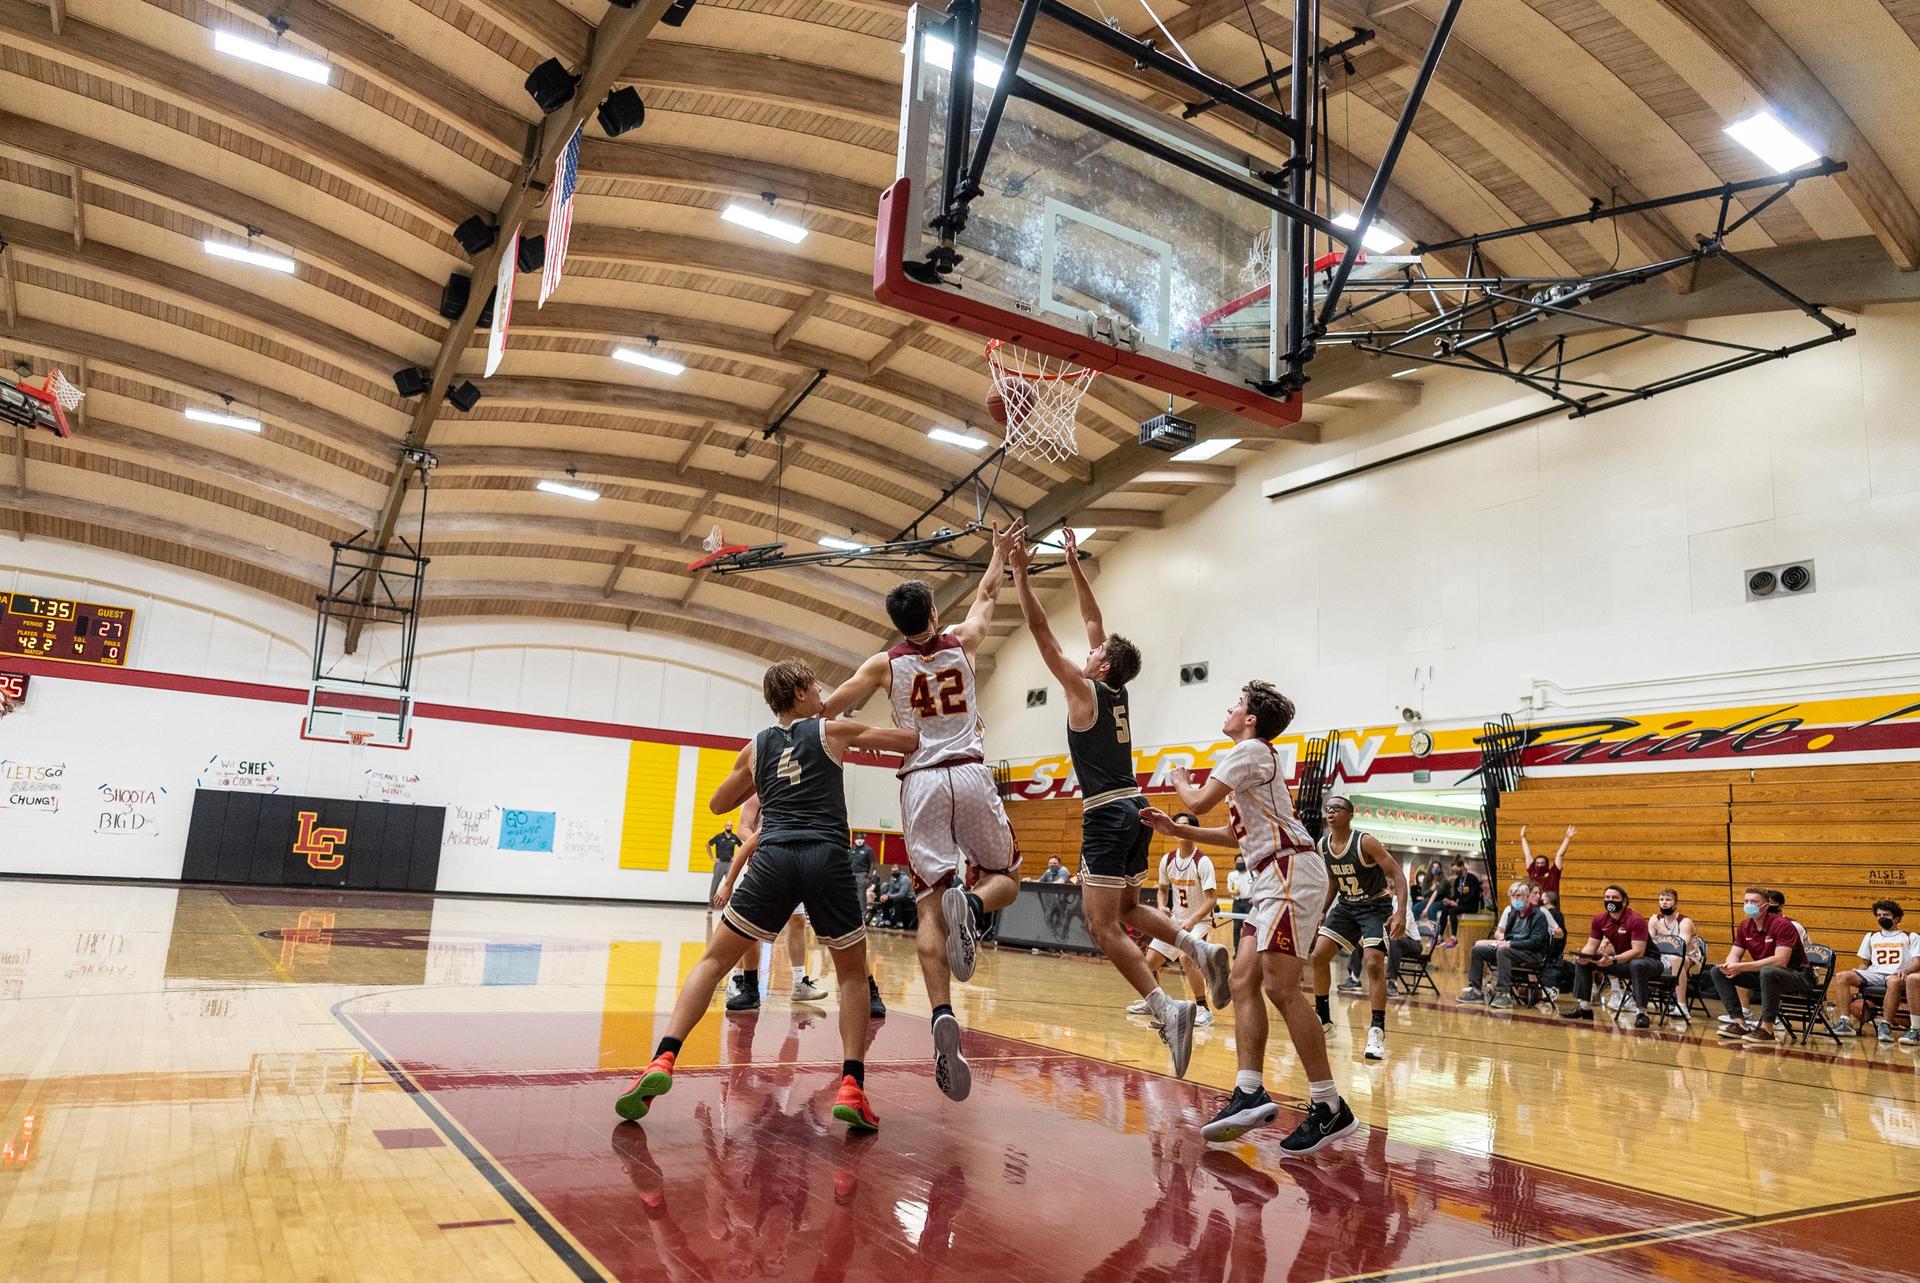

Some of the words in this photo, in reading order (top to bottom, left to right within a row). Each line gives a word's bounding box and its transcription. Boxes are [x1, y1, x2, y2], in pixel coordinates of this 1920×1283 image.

[30, 598, 70, 618] 7:35
[97, 608, 125, 619] GUEST
[16, 629, 38, 637] PLAYER
[22, 620, 43, 628] PERIOD
[46, 620, 55, 632] 3
[98, 621, 122, 637] 27
[18, 636, 37, 649] 42
[43, 639, 53, 651] 2
[74, 643, 84, 654] 4
[23, 648, 44, 656] MATCH
[109, 647, 118, 659] 0
[909, 668, 968, 718] 42
[1113, 706, 1130, 744] 5
[777, 746, 802, 786] 4
[9, 794, 56, 806] CHUNG!
[102, 787, 156, 805] SHOOTA
[99, 812, 126, 830] BIG
[132, 813, 145, 830] D
[454, 804, 473, 820] You
[474, 807, 492, 828] got
[462, 819, 480, 833] this
[293, 812, 347, 870] LC
[446, 830, 490, 847] Andrew
[1869, 869, 1905, 880] AISLE
[1178, 888, 1189, 909] 2
[1275, 931, 1291, 950] LC
[1876, 949, 1901, 965] 22
